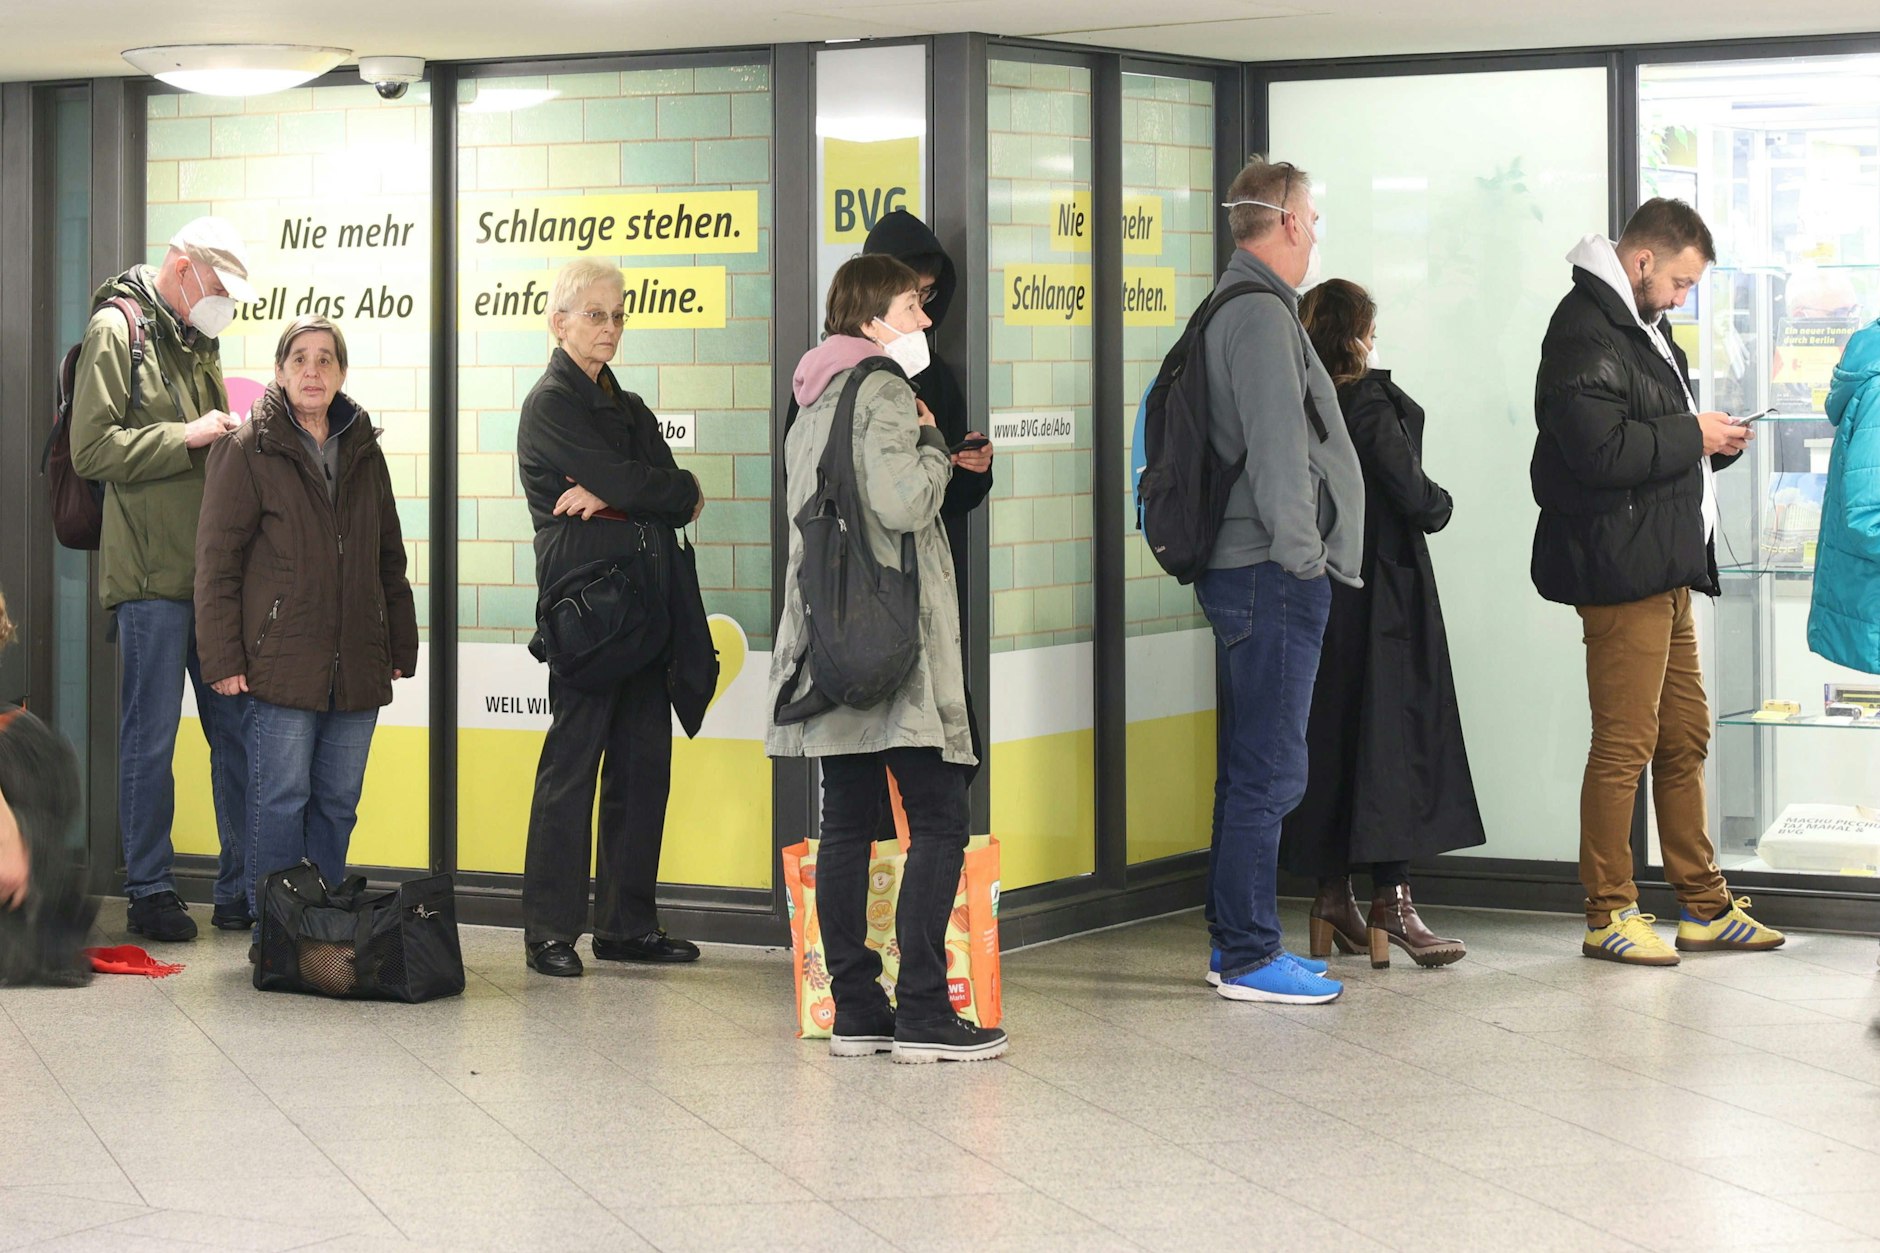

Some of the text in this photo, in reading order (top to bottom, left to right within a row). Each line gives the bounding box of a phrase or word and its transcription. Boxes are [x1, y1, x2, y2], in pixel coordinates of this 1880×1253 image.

[280, 214, 414, 249] Nie mehr
[476, 204, 740, 251] Schlange stehen.
[1058, 202, 1085, 237] Nie
[232, 285, 414, 321] tell das Abo
[474, 279, 704, 317] einfa nline.
[1012, 274, 1167, 320] Schlange tehen.
[1784, 327, 1798, 335] Ein
[1784, 336, 1836, 344] durch Berlin
[994, 417, 1071, 438] www.BVG.de/Abo
[486, 696, 524, 714] WEIL
[1806, 824, 1851, 832] MAHAL
[948, 983, 965, 994] WE
